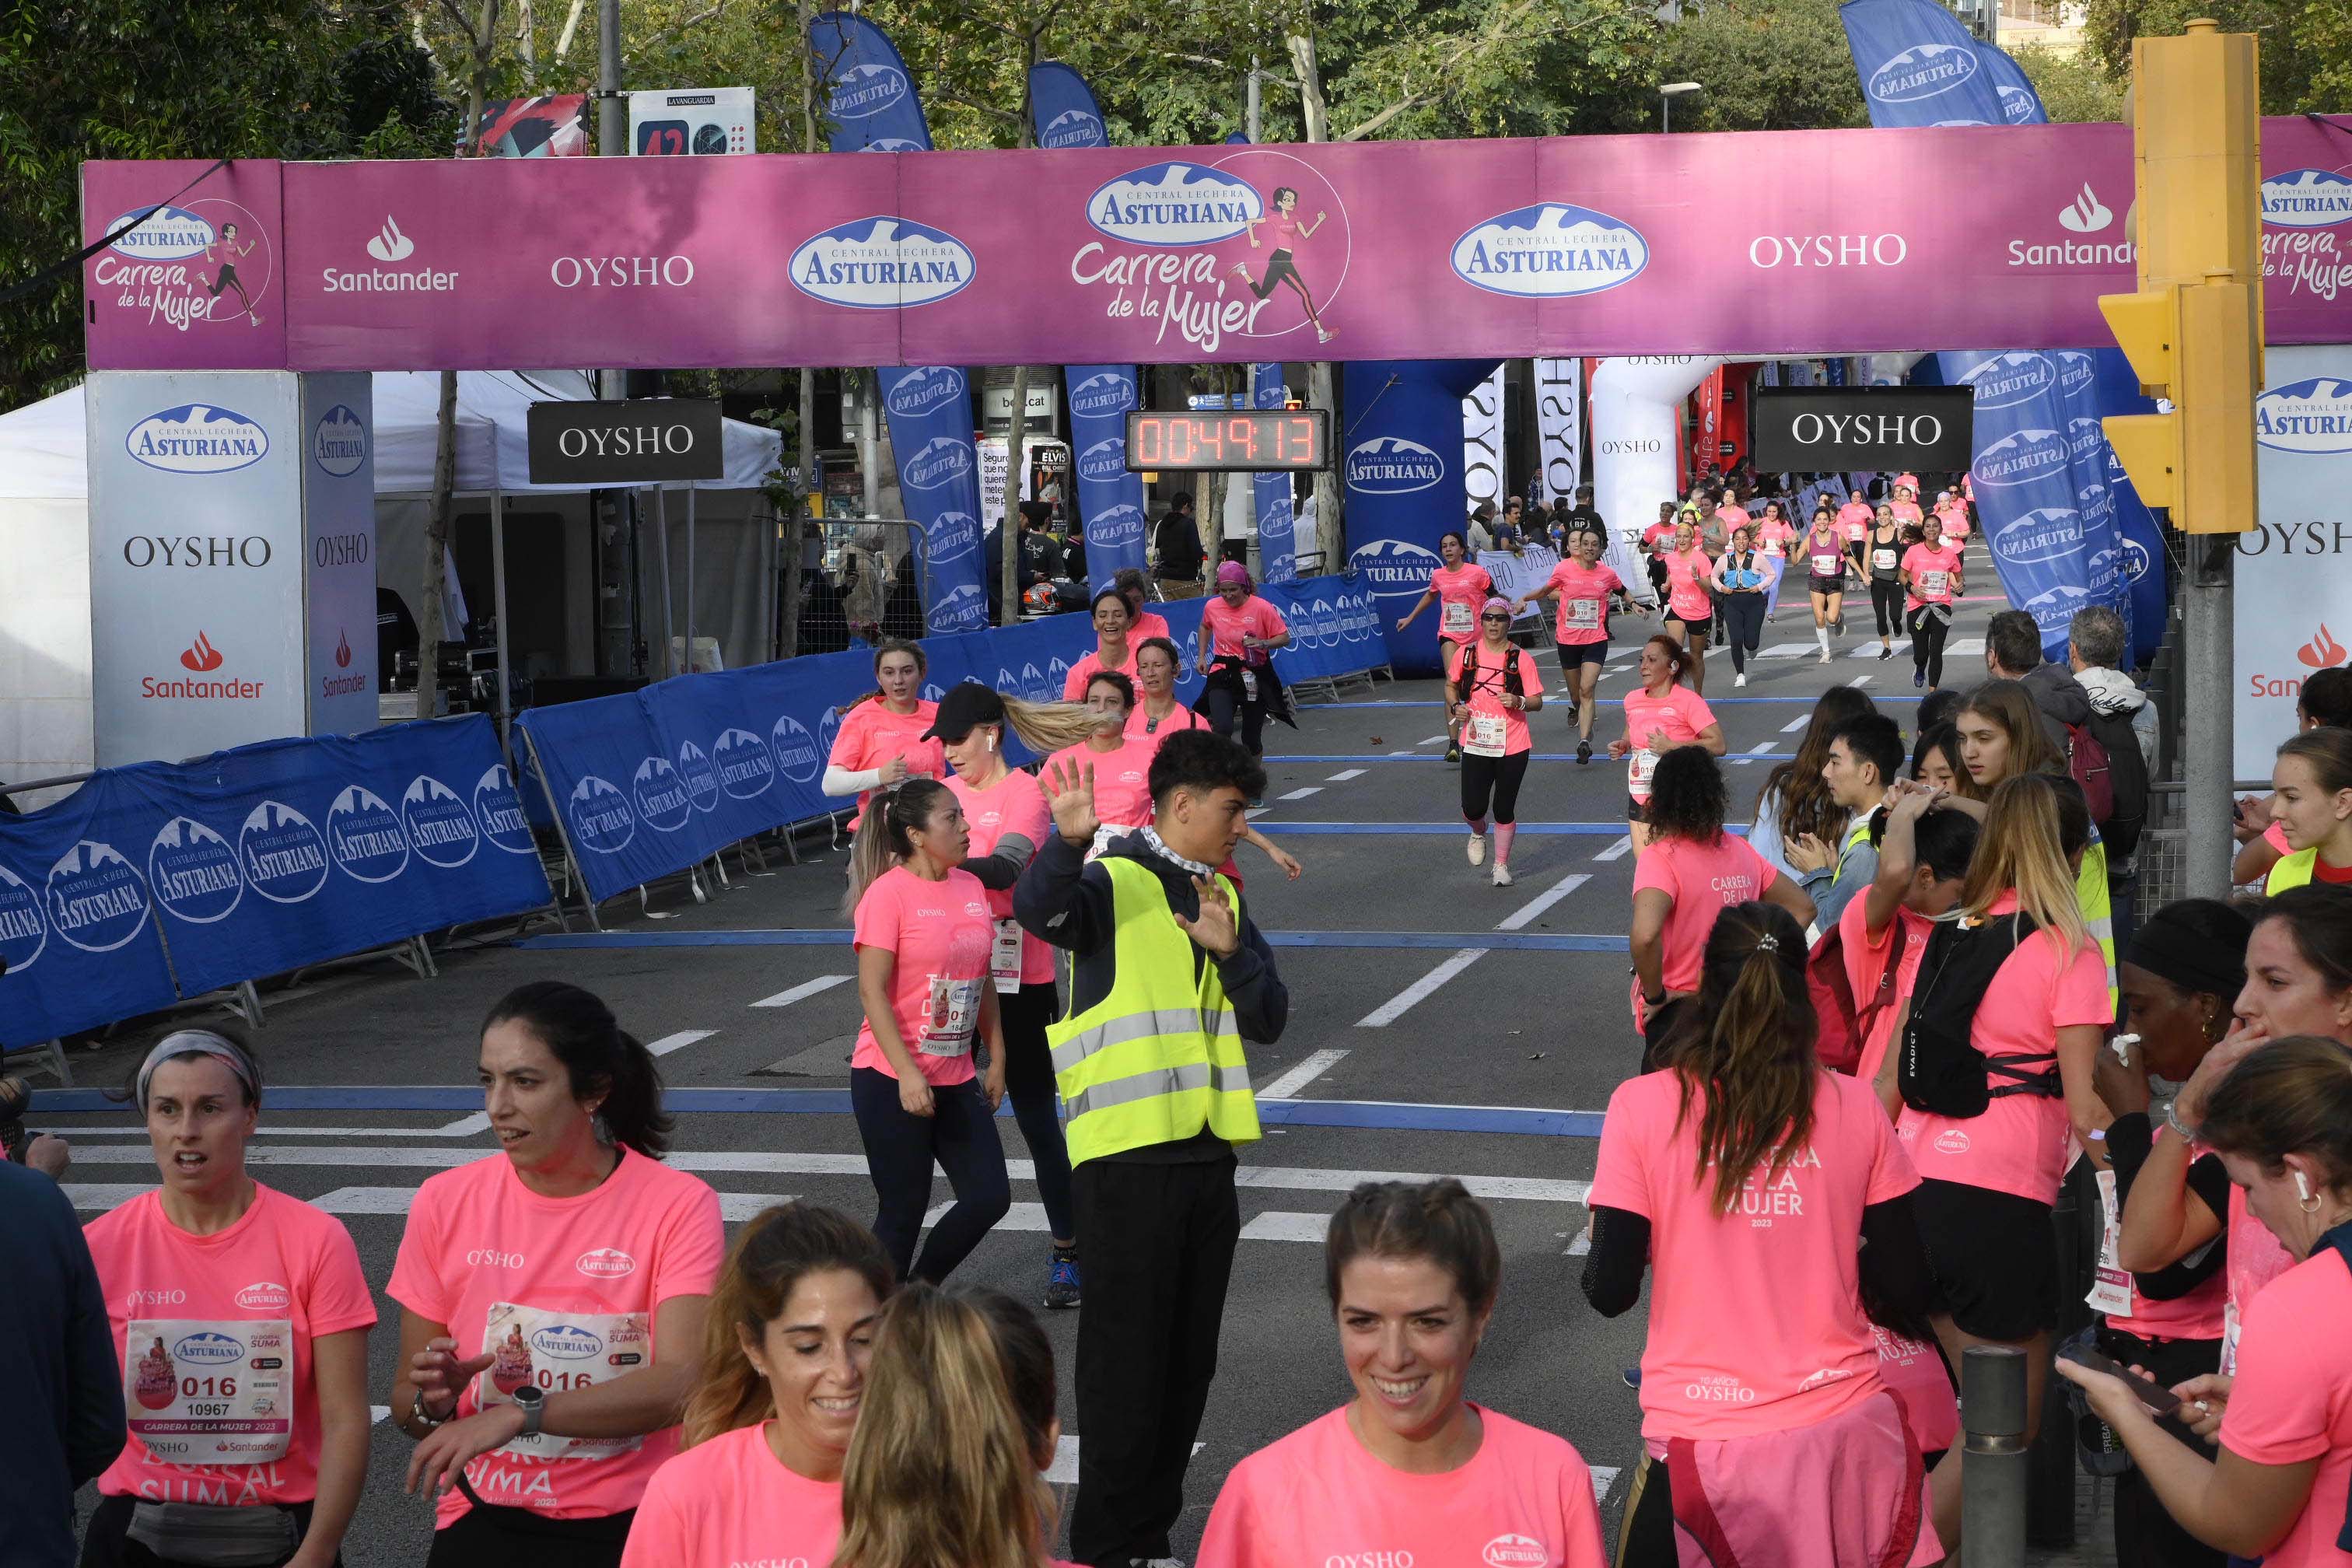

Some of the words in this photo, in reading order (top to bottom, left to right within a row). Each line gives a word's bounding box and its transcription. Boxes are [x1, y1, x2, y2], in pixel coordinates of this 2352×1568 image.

[1188, 191, 1244, 199] LECHERA
[1101, 193, 1248, 224] ASTURIANA
[1496, 236, 1556, 247] CENTRAL
[1564, 233, 1627, 243] LECHERA
[1749, 233, 1907, 268] OYSHO
[2262, 232, 2335, 254] arrera
[831, 249, 890, 257] CENTRAL
[896, 247, 955, 257] LECHERA
[1466, 239, 1633, 274] ASTURIANA
[2008, 239, 2137, 265] Santand
[95, 257, 186, 285] Carrera
[551, 255, 695, 288] OYSHO
[802, 250, 961, 284] ASTURIANA
[1071, 242, 1216, 285] Carrera
[324, 268, 458, 292] Santander
[2280, 255, 2293, 276] la
[2291, 250, 2352, 300] Muje
[118, 287, 135, 306] de
[138, 287, 151, 306] la
[149, 283, 221, 331] Mujer
[1108, 287, 1133, 317] de
[1140, 287, 1159, 317] la
[1156, 279, 1271, 352] Mujer
[2277, 404, 2330, 412] CENTRAL
[1792, 413, 1941, 445] OYSHO
[137, 430, 259, 456] ASTURIANA
[318, 435, 363, 460] ASTURIANA
[558, 425, 694, 457] OYSHO
[1601, 439, 1661, 455] OYSHO
[1042, 453, 1066, 462] ELVIS
[1349, 460, 1437, 481] ASTURIANA
[124, 535, 271, 568] OYSHO
[316, 533, 367, 567] OYSHO
[142, 677, 264, 698] Santander
[323, 673, 366, 698] Santander
[717, 755, 772, 786] ASTURIANA
[408, 813, 475, 849] ASTURIANA
[334, 824, 405, 863] ASTURIANA
[247, 843, 325, 883] ASTURIANA
[158, 861, 240, 902] ASTURIANA
[1711, 875, 1752, 891] CARRERA
[1723, 891, 1736, 904] DE
[1738, 891, 1748, 902] LA
[1752, 1220, 1773, 1228] 2023
[580, 1258, 631, 1272] ASTURIANA
[127, 1290, 186, 1307] OYSHO
[240, 1293, 288, 1304] ASTURIANA
[180, 1346, 239, 1357] ASTURIANA
[250, 1339, 281, 1348] SUMA
[537, 1336, 597, 1353] ASTURIANA
[181, 1377, 236, 1397] 016
[537, 1368, 592, 1391] 016
[1710, 1375, 1739, 1386] AÑOS
[1685, 1384, 1755, 1402] OYSHO
[187, 1404, 229, 1416] 10967
[254, 1423, 276, 1431] 2023
[144, 1440, 188, 1454] OYSHO
[229, 1442, 279, 1452] Santander
[534, 1498, 558, 1507] 2023
[1325, 1550, 1414, 1568] OYSHO
[1489, 1546, 1545, 1563] ASTURIANA
